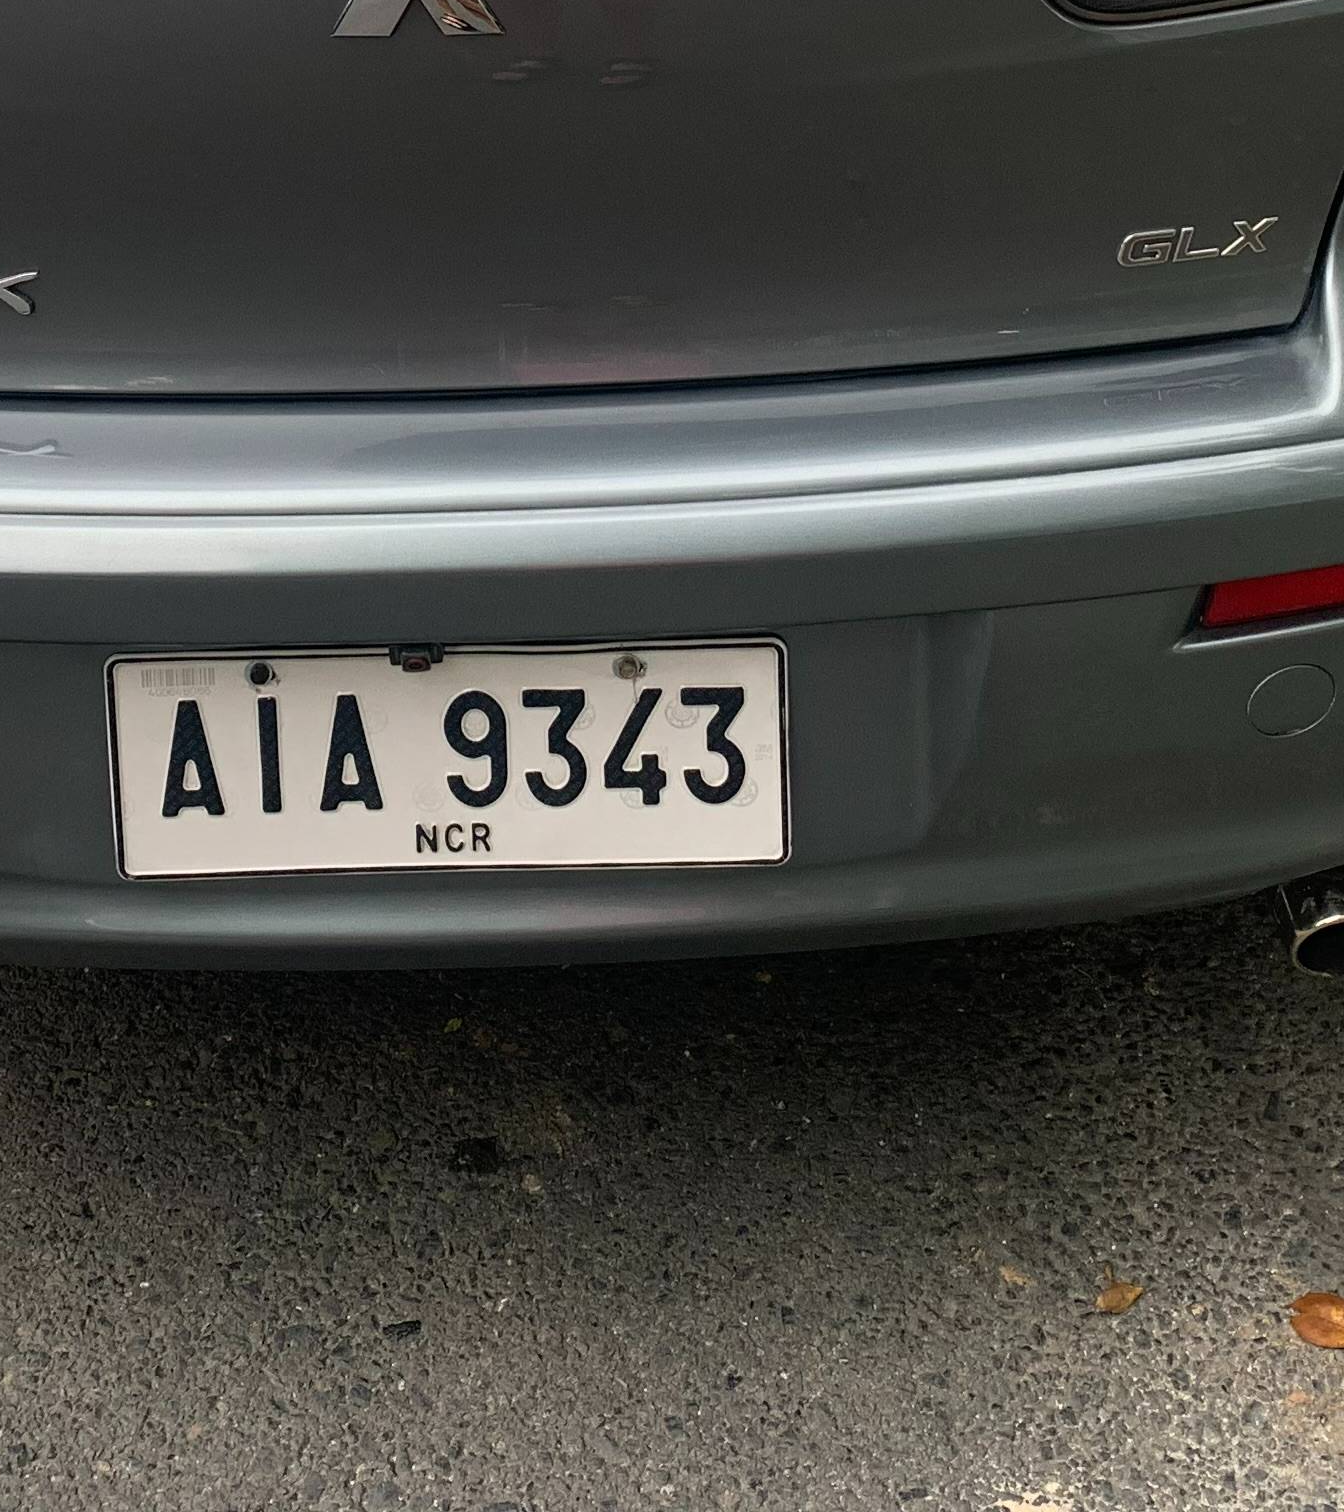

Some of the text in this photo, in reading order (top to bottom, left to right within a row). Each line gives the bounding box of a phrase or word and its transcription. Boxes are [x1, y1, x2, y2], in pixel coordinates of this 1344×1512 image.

[1116, 216, 1279, 268] GLX
[161, 686, 747, 817] AIA 9343
[415, 821, 493, 854] NCR
